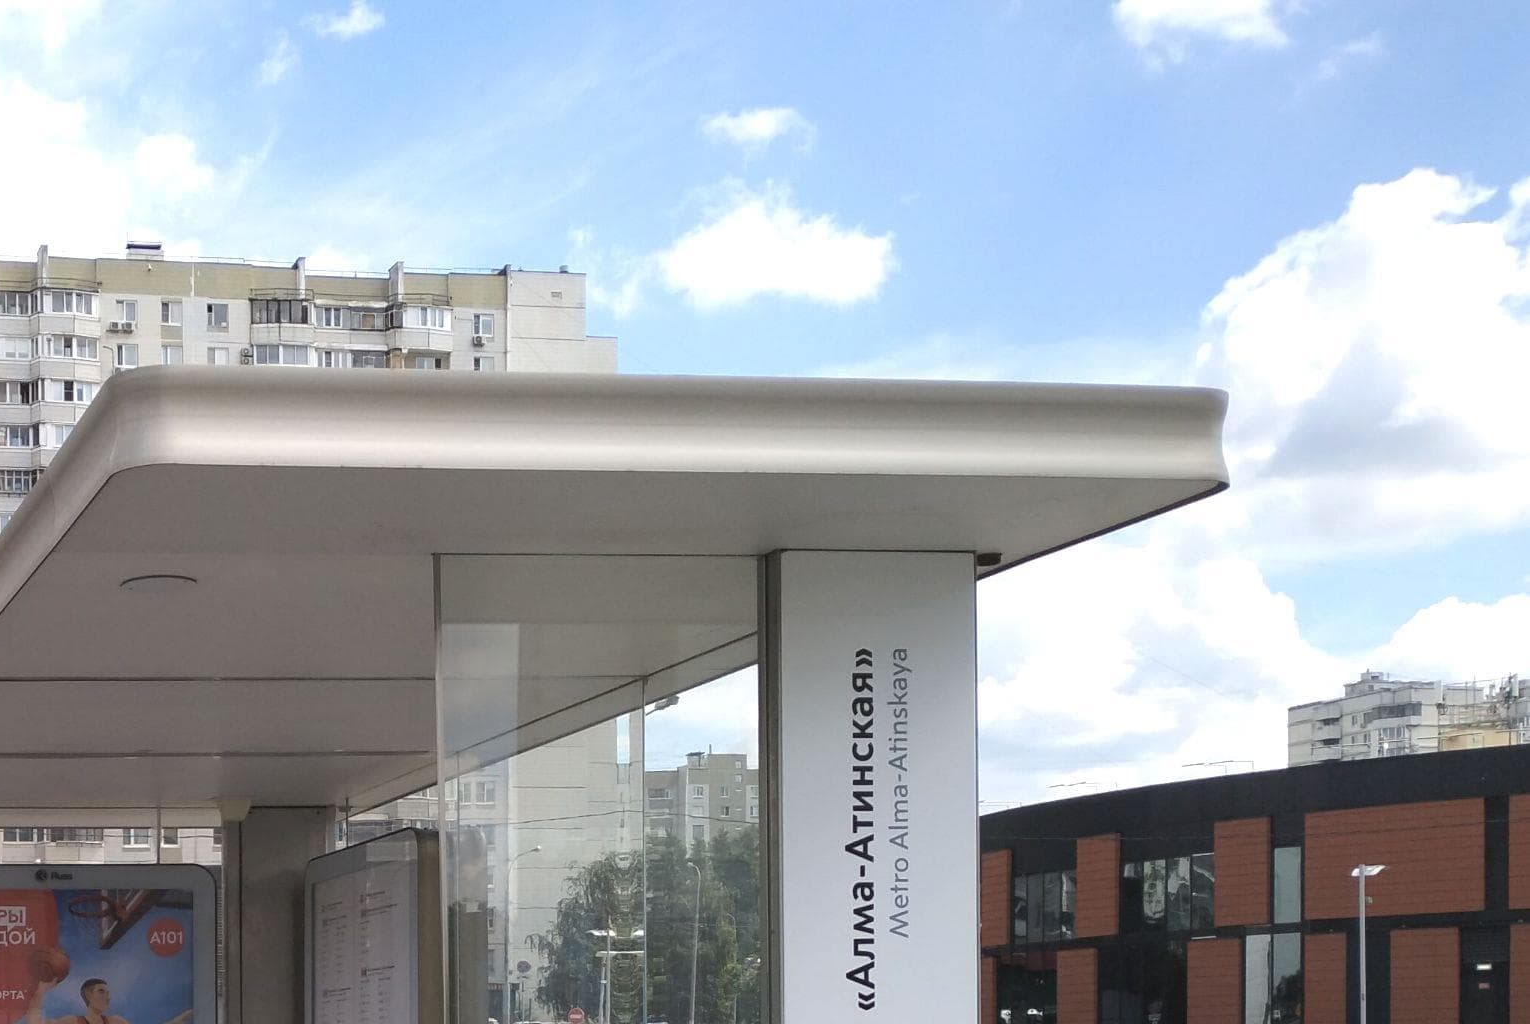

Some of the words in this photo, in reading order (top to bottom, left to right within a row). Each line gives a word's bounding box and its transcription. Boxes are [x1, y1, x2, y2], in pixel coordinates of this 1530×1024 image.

[845, 648, 875, 1011] «Алма-Атинская»
[887, 648, 912, 850] Alma-Atinskaya
[888, 856, 909, 938] Metro
